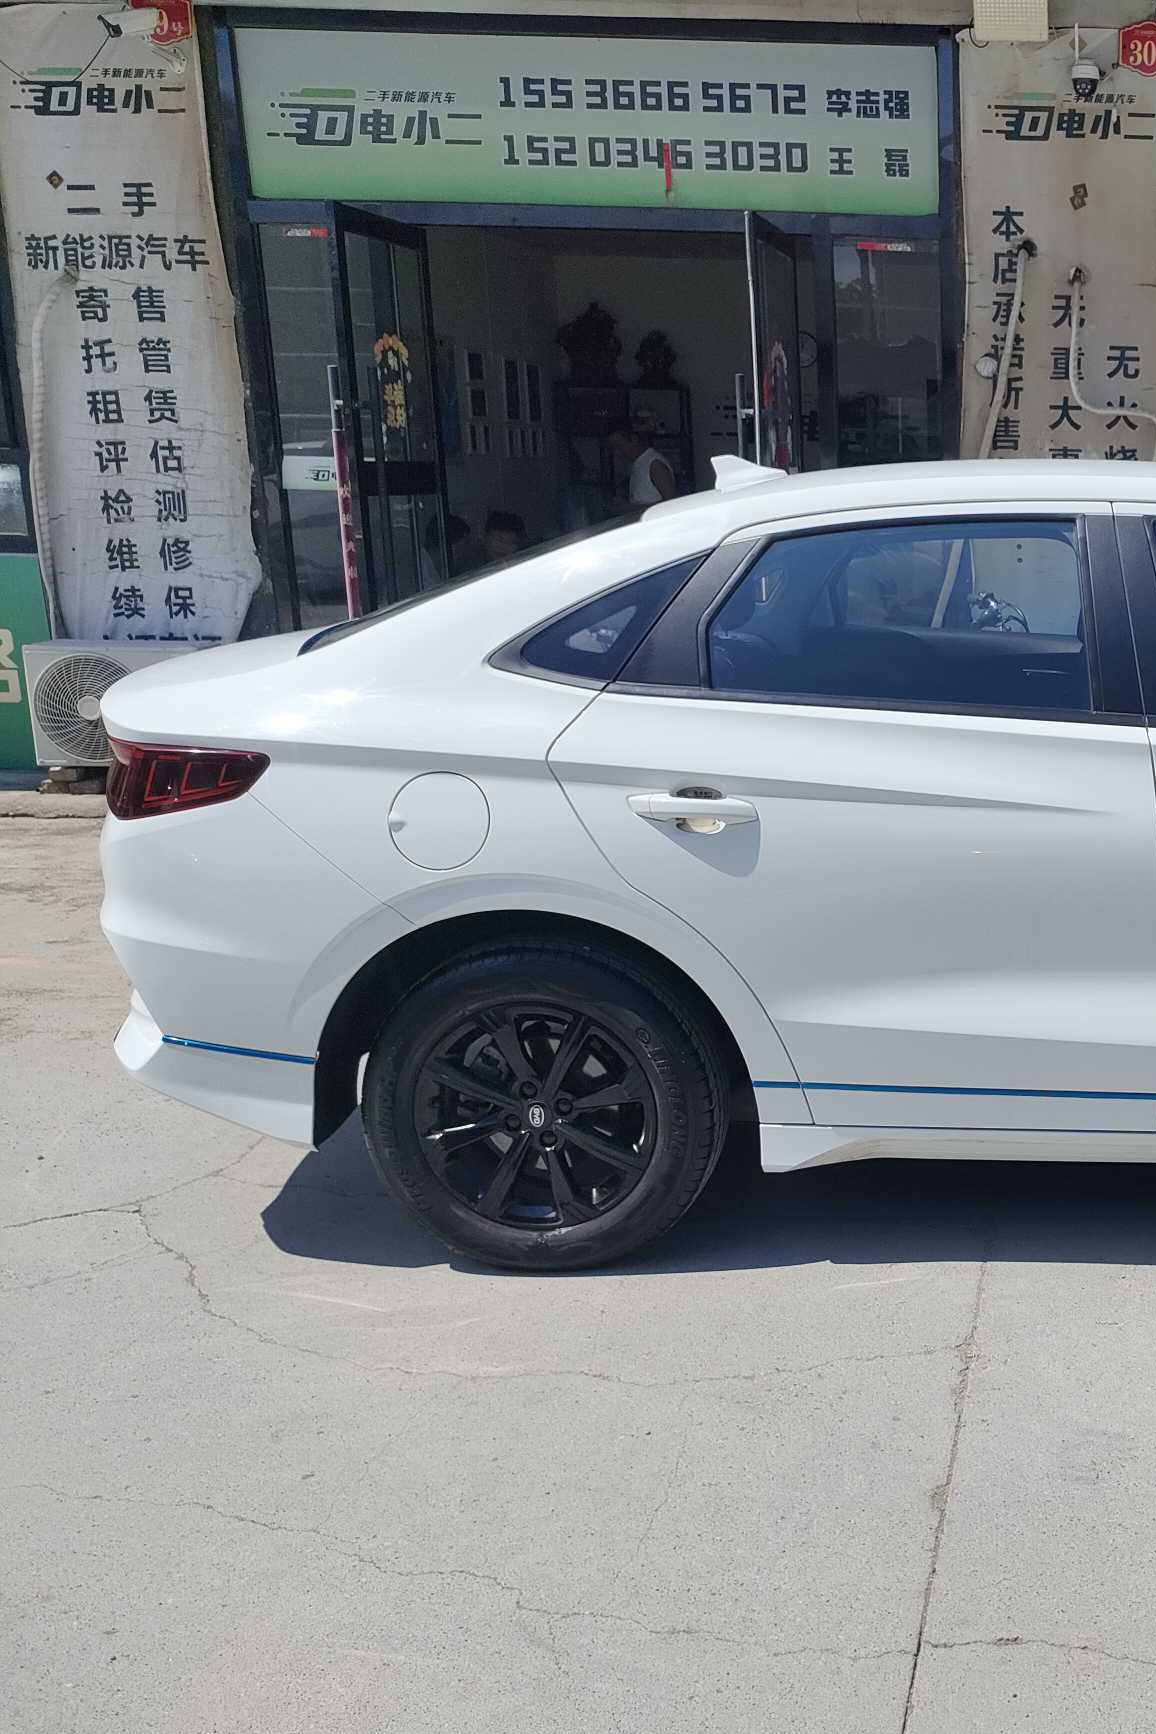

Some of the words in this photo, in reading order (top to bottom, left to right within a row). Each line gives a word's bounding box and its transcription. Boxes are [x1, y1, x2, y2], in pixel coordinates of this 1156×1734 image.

[89, 67, 168, 80] 二手新能源汽车
[86, 83, 186, 114] 电小二
[366, 89, 457, 104] 二手新能源汽车
[499, 76, 575, 109] 155
[584, 78, 691, 113] 3666
[702, 81, 807, 116] 5672
[825, 88, 911, 120] 李志强
[360, 108, 482, 145] 电小二
[1056, 109, 1156, 140] 电小二
[503, 134, 578, 168] 152
[587, 136, 694, 171] 0346
[703, 139, 808, 174] 3030
[24, 233, 210, 272] 新能源汽车
[75, 286, 168, 325] 寄售
[80, 337, 173, 375] 托管
[87, 390, 180, 425] 租赁
[94, 439, 184, 475] 评估
[100, 488, 188, 525] 检测
[105, 538, 193, 573] 维修
[111, 585, 197, 620] 续保
